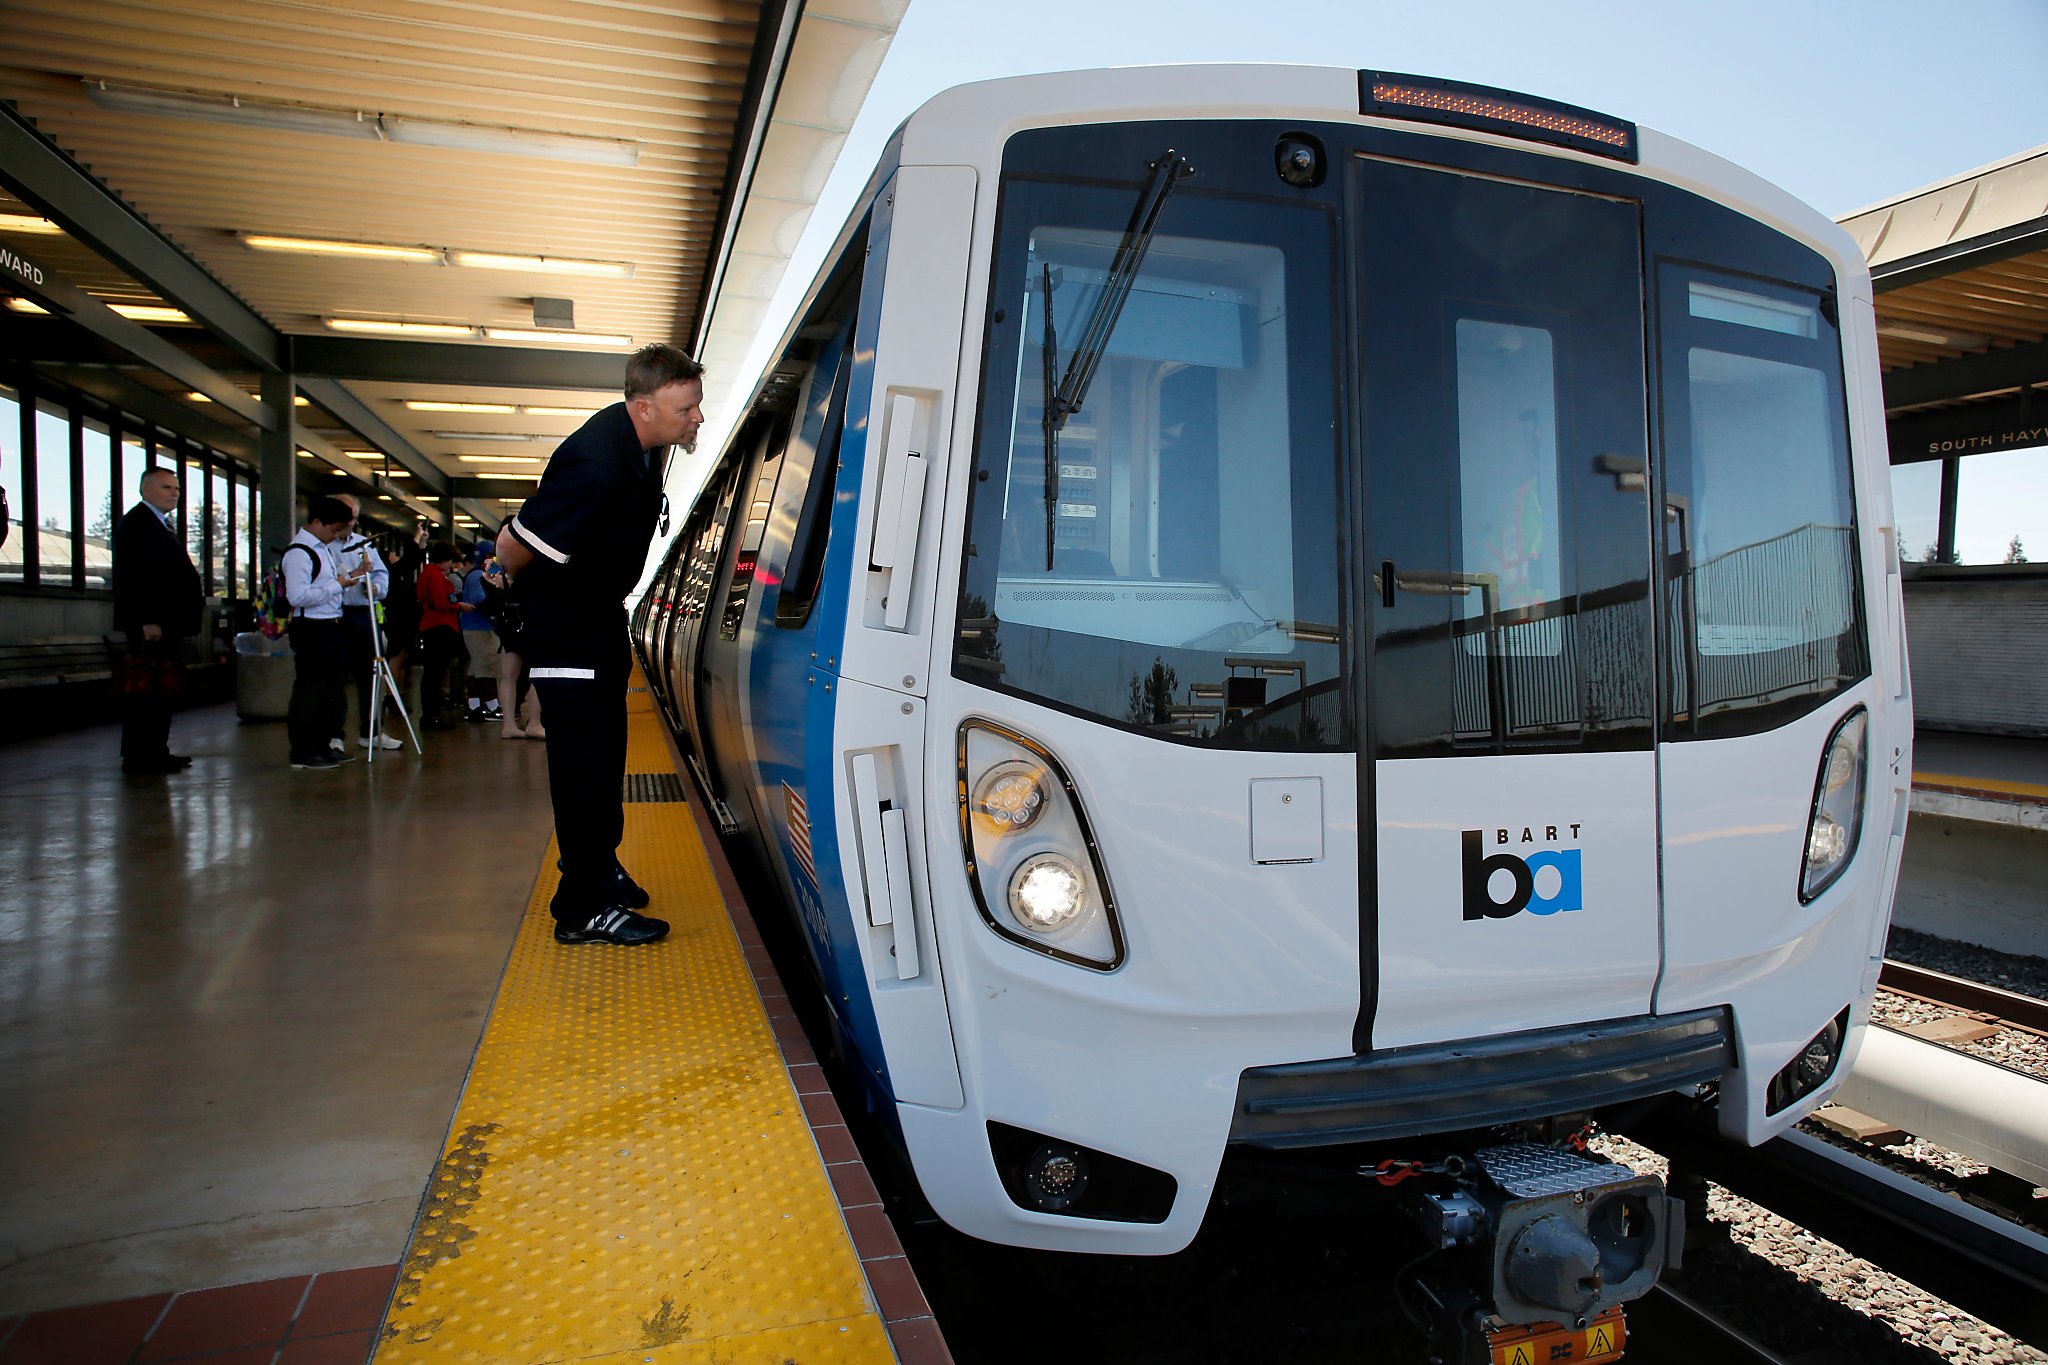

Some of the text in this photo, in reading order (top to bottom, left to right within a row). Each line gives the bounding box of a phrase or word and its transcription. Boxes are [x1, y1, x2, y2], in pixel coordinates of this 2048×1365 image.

[1929, 427, 2048, 453] SOUTH HAY
[1497, 824, 1581, 845] BART
[1461, 829, 1582, 921] ba
